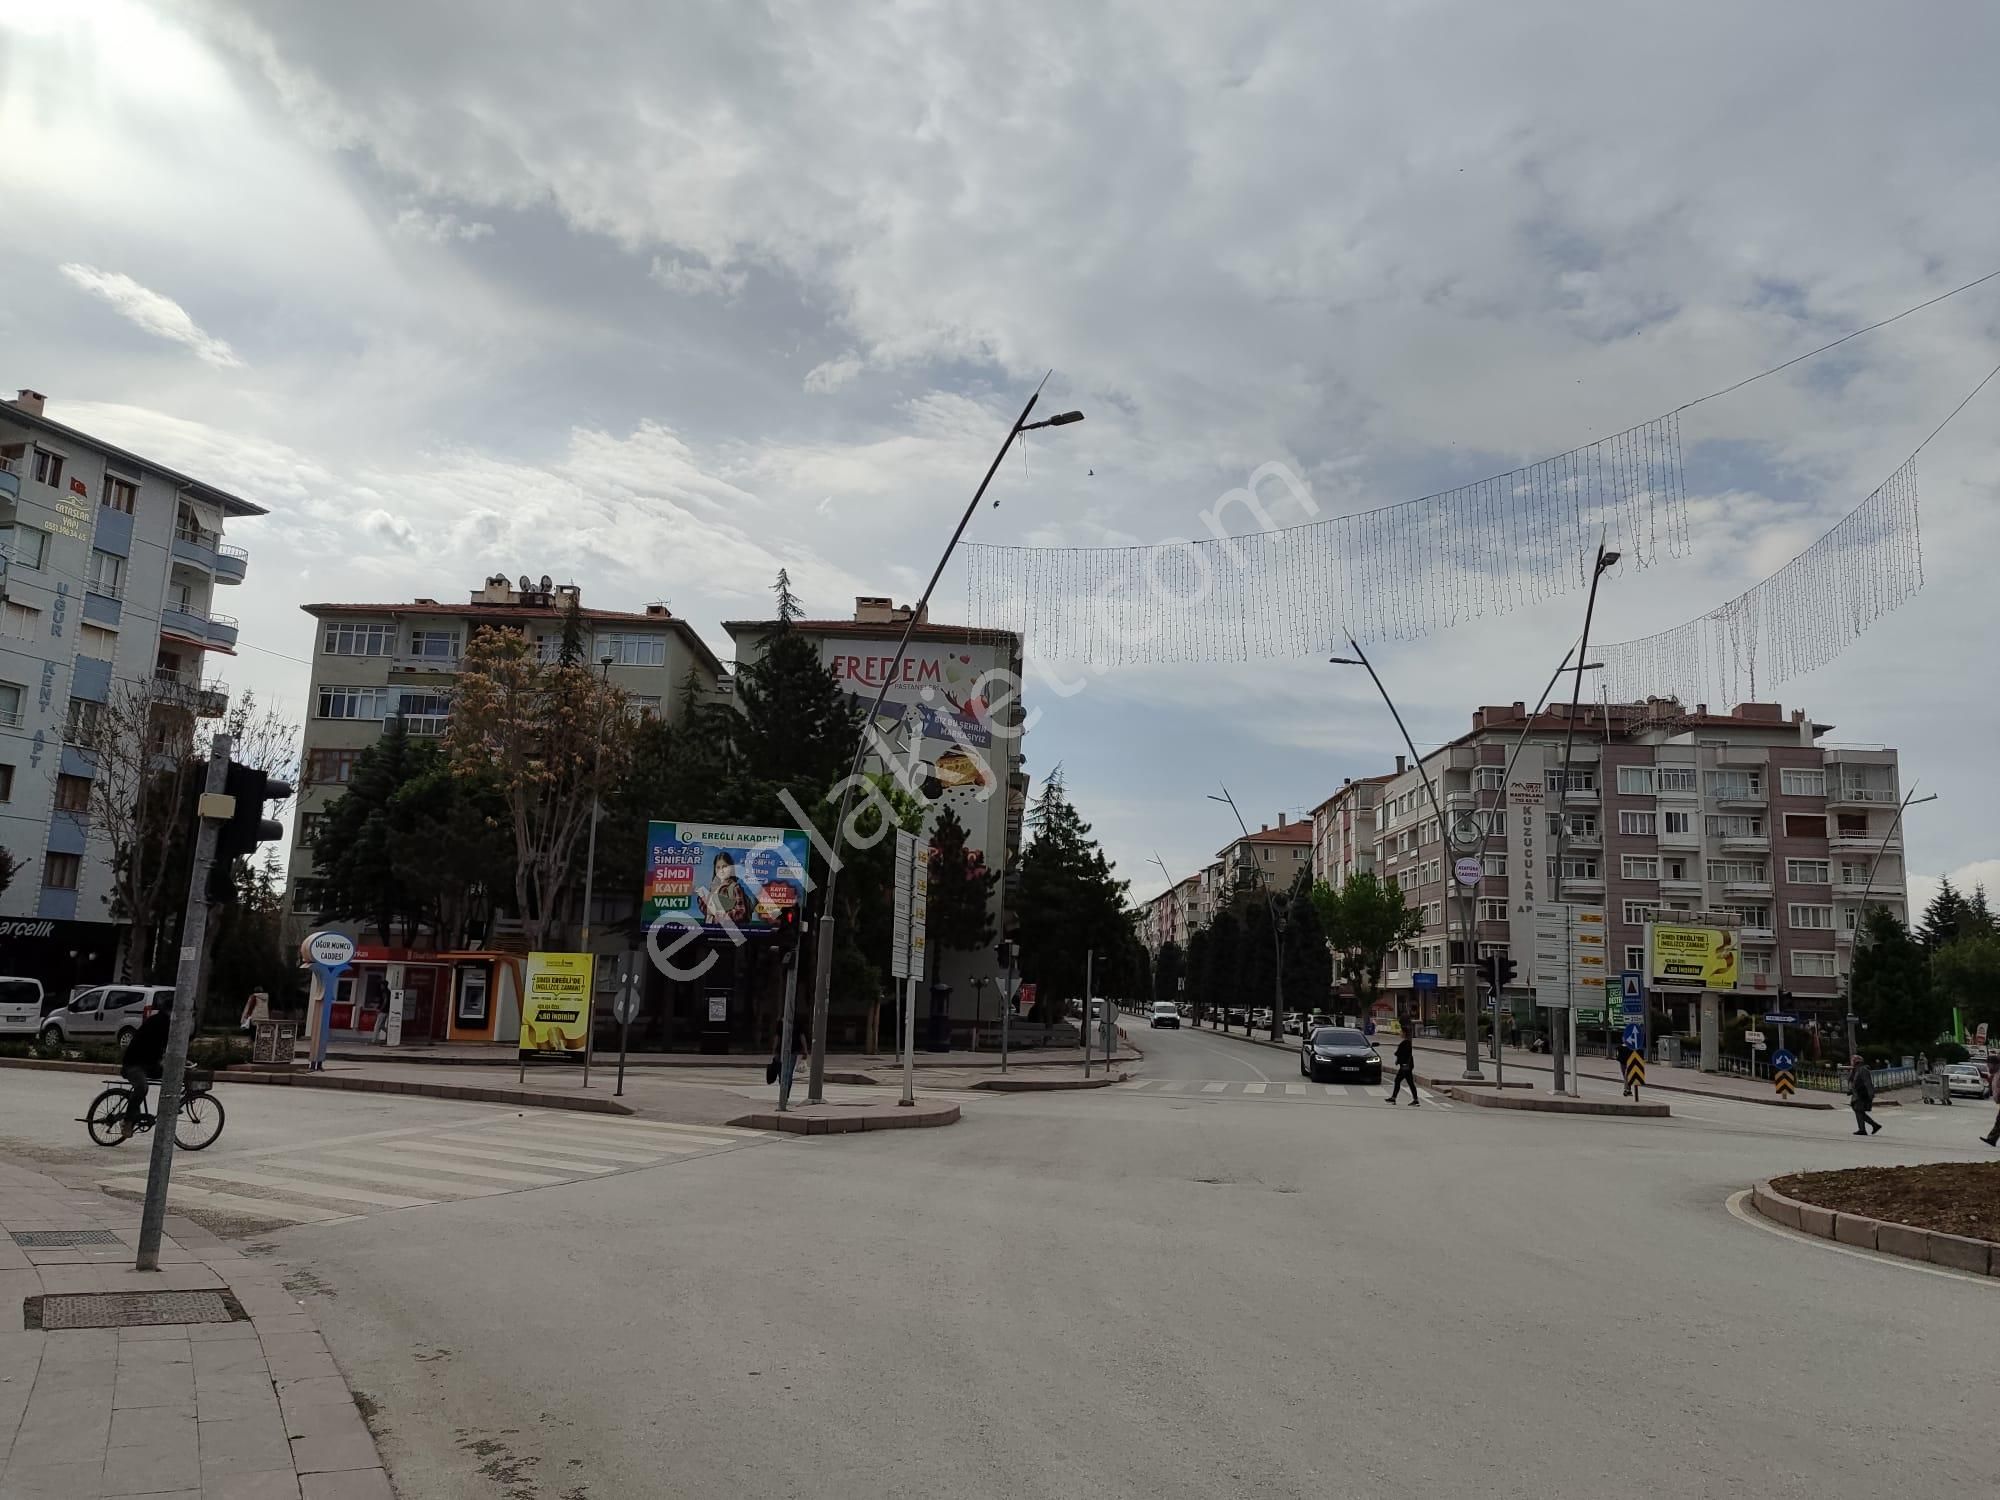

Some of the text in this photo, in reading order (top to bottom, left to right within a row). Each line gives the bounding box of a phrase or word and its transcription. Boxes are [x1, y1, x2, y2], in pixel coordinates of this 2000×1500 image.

[63, 516, 79, 530] YAPI
[832, 655, 941, 687] EREDEM
[38, 661, 56, 713] KENT
[29, 729, 44, 768] APT
[701, 832, 779, 843] EREĞLİ AKADEMİ
[654, 856, 700, 864] SINIFLAR
[656, 867, 690, 880] ŞİMDİ
[655, 883, 690, 893] KAYIT
[654, 896, 689, 908] VAKTİ
[0, 920, 55, 939] arçelik
[315, 940, 351, 950] UĞUR MUMCU
[321, 951, 344, 961] CADDESİ
